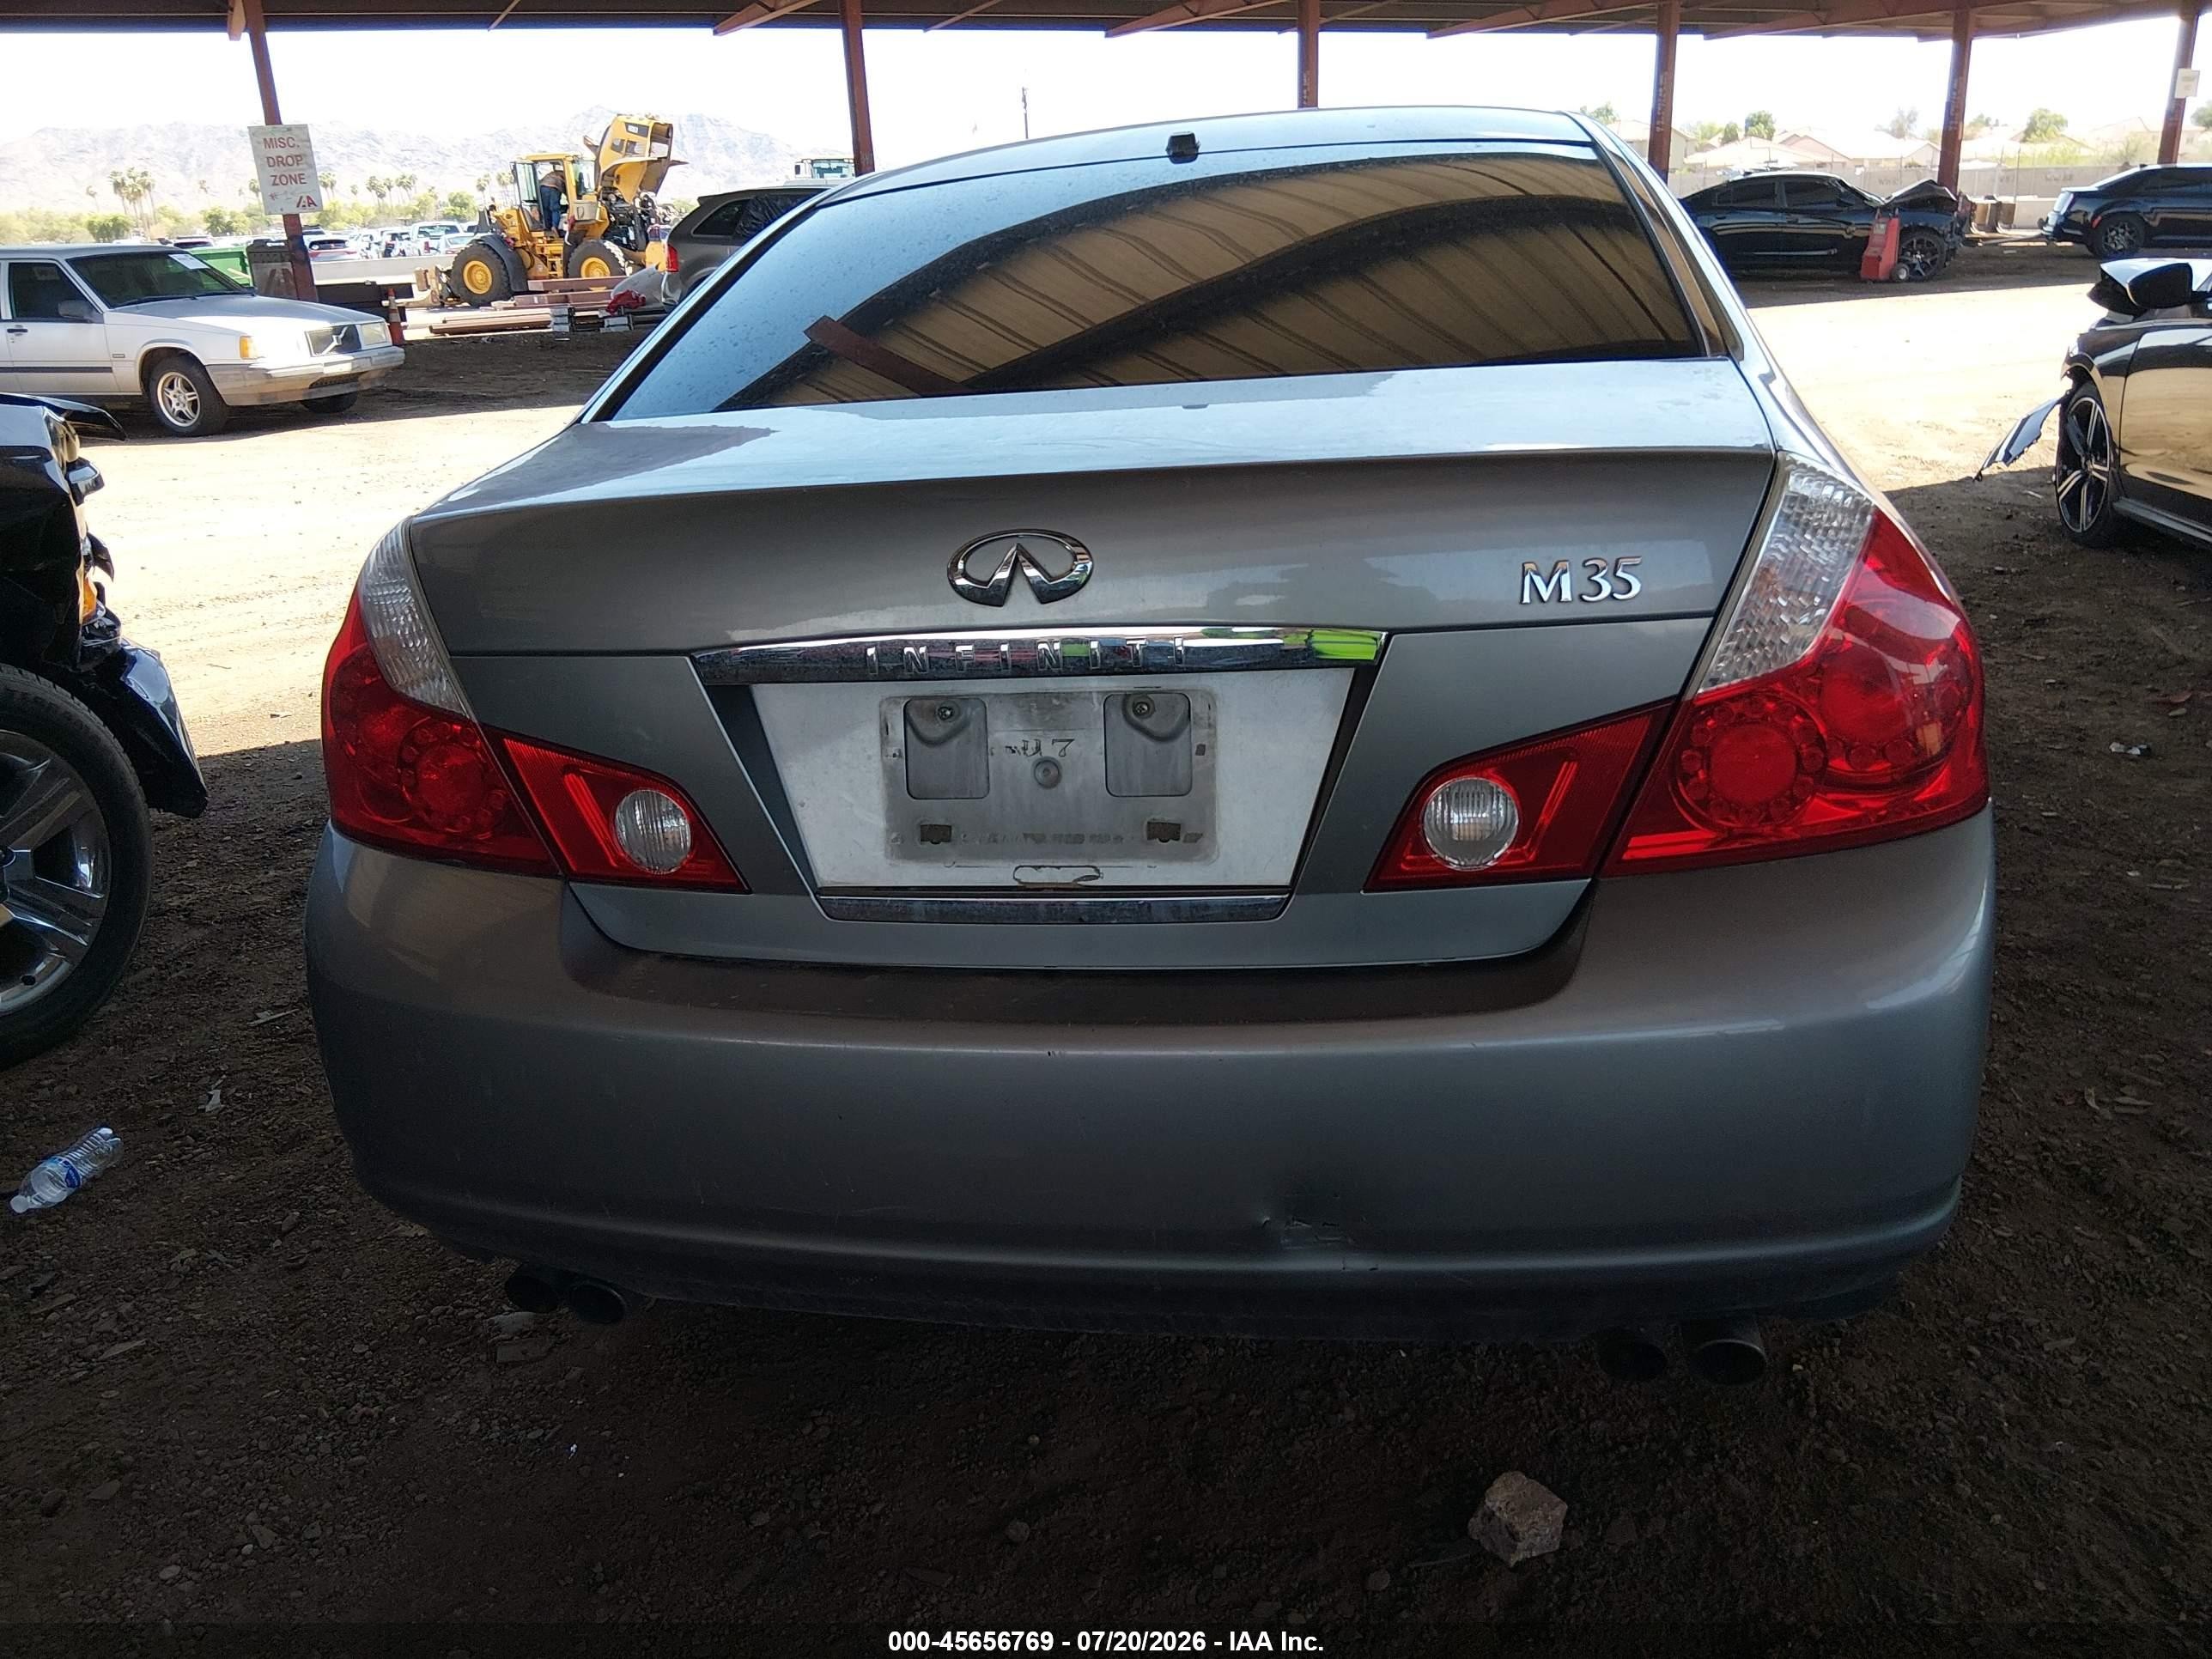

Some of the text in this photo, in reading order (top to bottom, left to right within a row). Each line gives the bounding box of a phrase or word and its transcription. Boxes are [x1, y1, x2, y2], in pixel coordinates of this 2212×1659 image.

[263, 137, 300, 149] MISC.
[266, 155, 303, 167] DROP
[270, 173, 307, 186] ZONE
[1520, 556, 1643, 605] M 35
[866, 634, 1184, 675] INFINITI
